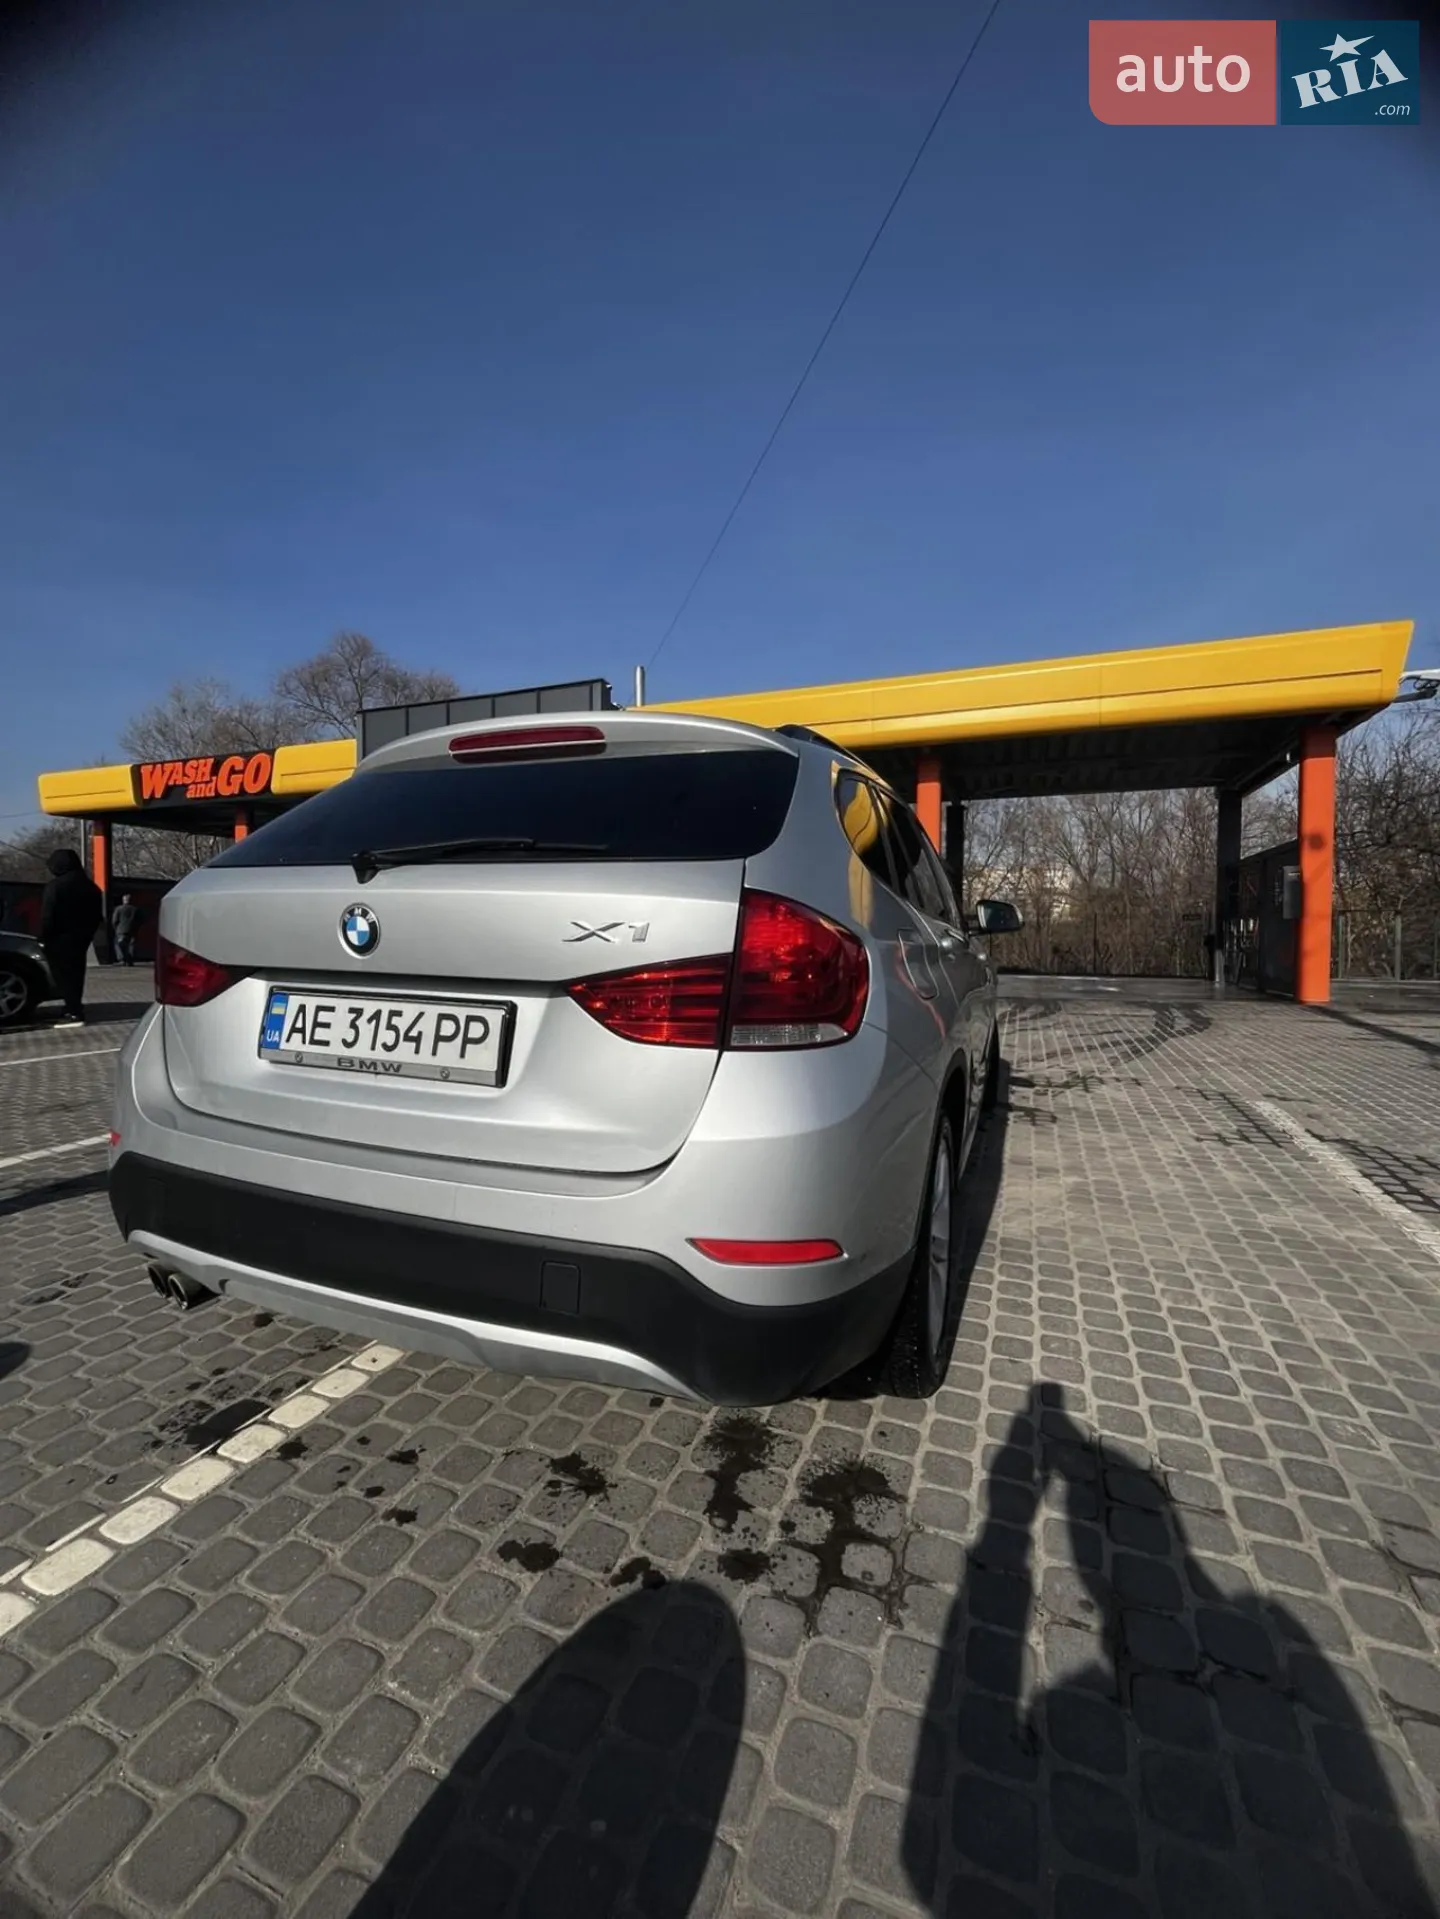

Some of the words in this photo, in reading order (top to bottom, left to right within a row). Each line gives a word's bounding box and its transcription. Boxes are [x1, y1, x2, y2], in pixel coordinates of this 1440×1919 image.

[140, 757, 215, 799] WASH
[186, 776, 217, 798] and
[217, 753, 271, 796] GO
[561, 921, 650, 943] X1
[266, 1030, 280, 1042] UA
[285, 1003, 336, 1047] AE
[341, 1007, 426, 1055] 3154
[431, 1012, 490, 1059] PP
[337, 1057, 402, 1073] BMW
